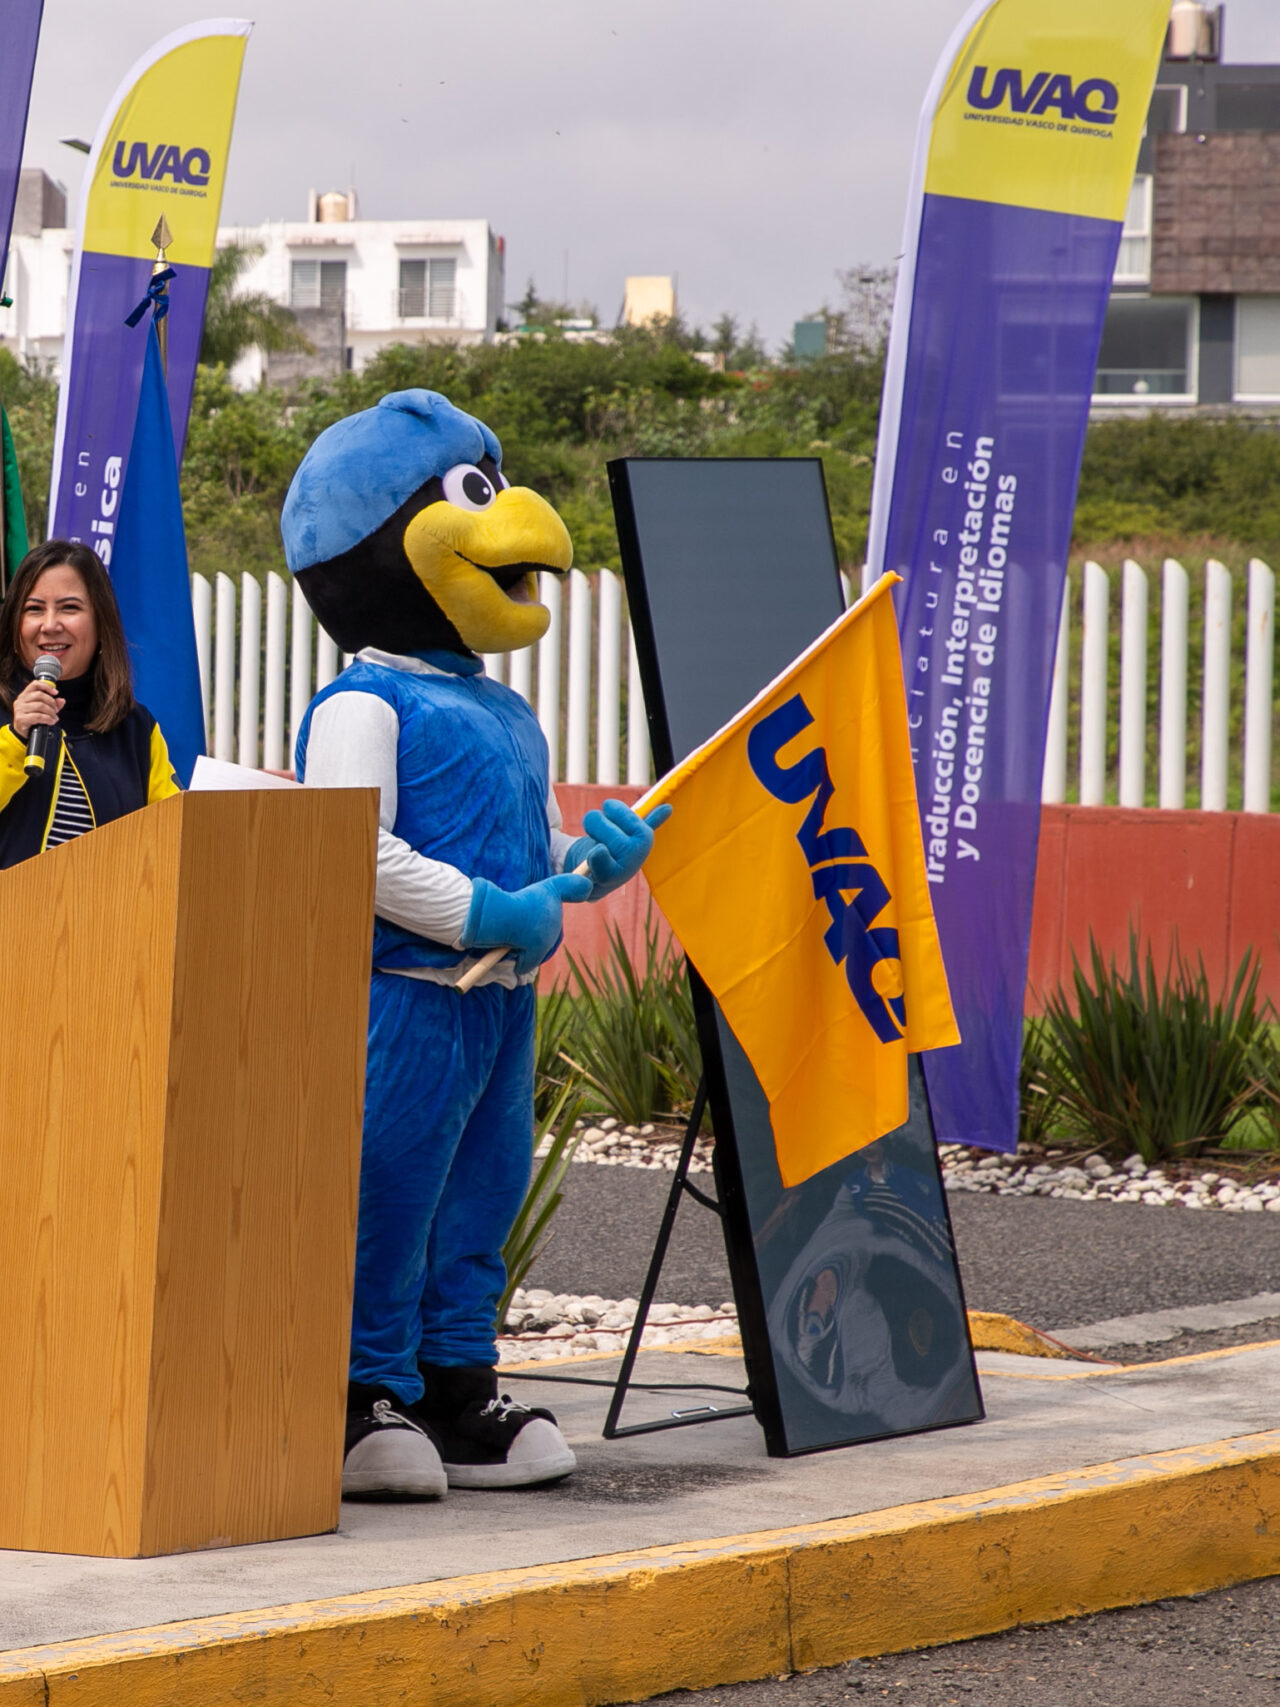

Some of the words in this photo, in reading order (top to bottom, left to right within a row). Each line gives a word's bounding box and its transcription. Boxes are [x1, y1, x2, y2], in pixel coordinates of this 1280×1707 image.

[966, 65, 1119, 125] UVAQ
[963, 112, 1024, 126] UNIVERSIDAD
[1025, 118, 1055, 130] VASCO
[1056, 123, 1068, 133] DE
[1070, 125, 1113, 139] QUIROGA
[112, 140, 211, 186] UVAQ
[74, 451, 90, 497] en
[942, 430, 965, 484] en
[91, 456, 123, 565] sica
[940, 435, 995, 686] Interpretación
[976, 473, 1018, 613] Idiomas
[970, 622, 998, 667] de
[953, 676, 992, 830] Docencia
[747, 692, 907, 1045] UVAQ
[956, 838, 981, 861] y
